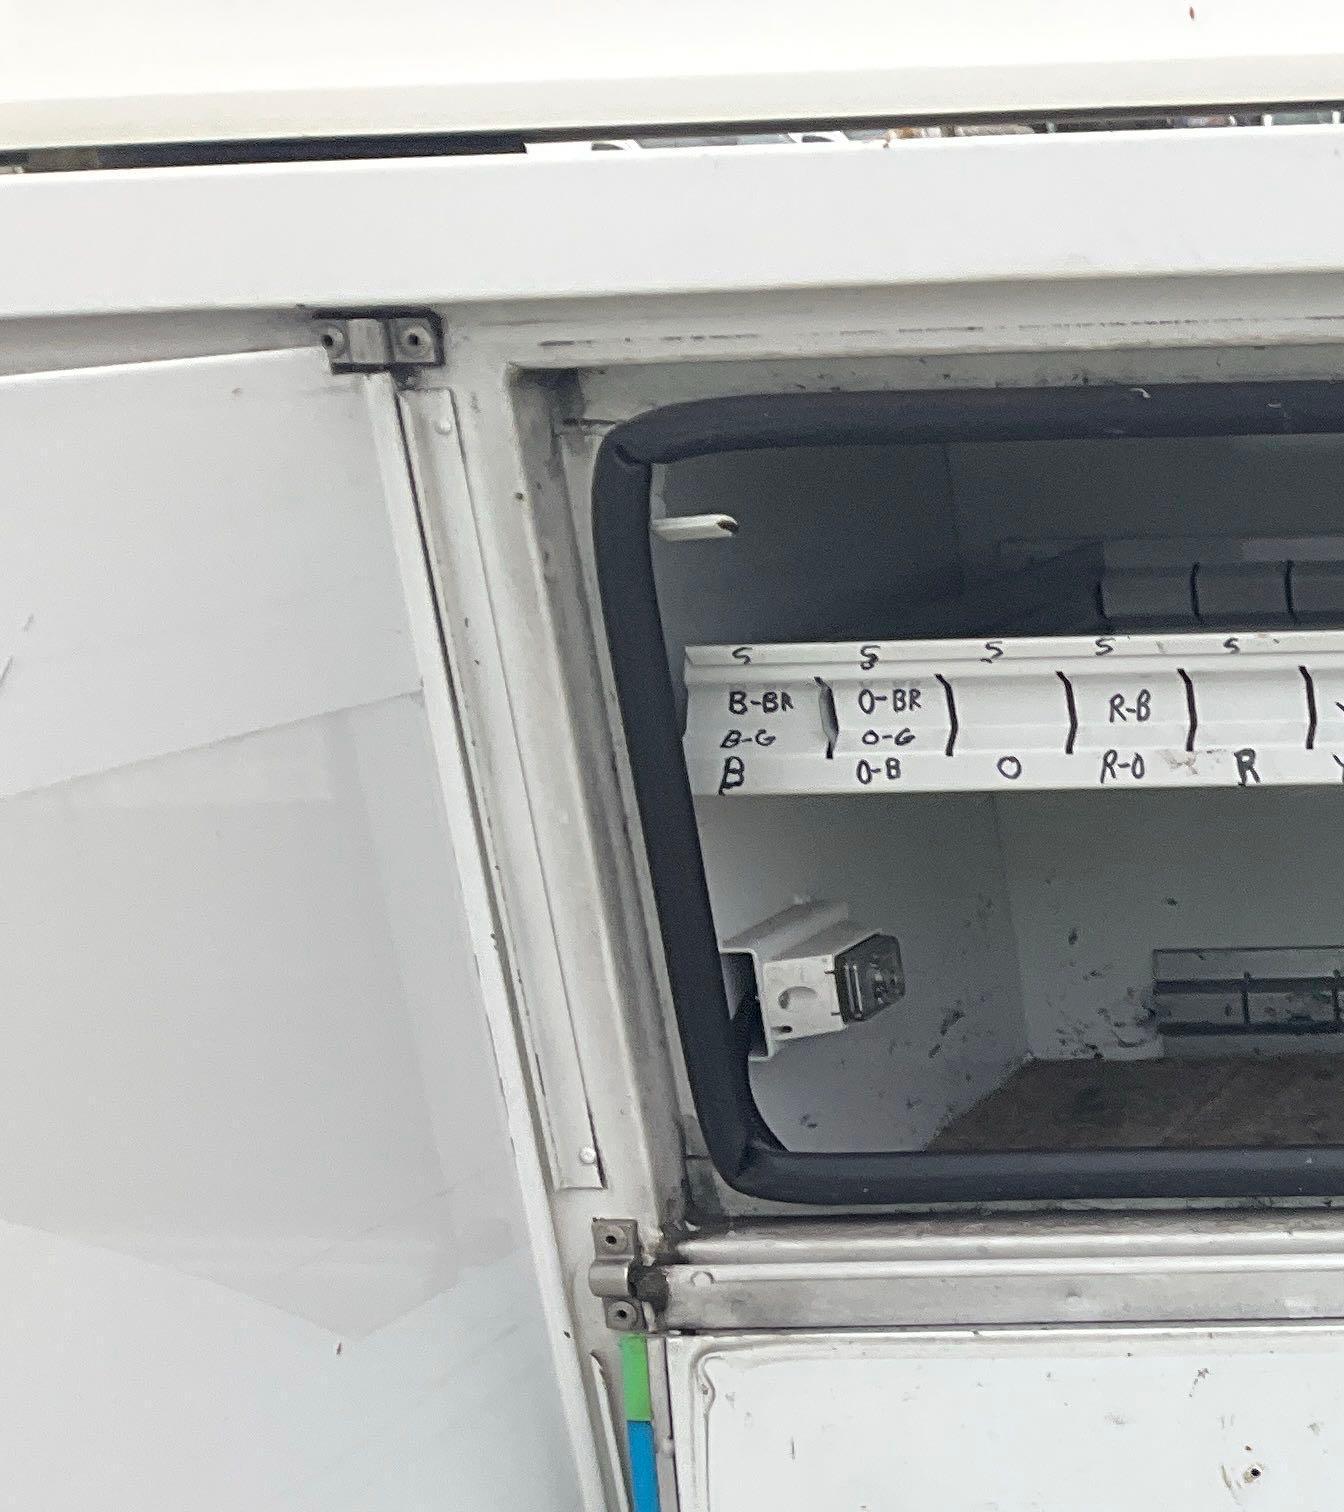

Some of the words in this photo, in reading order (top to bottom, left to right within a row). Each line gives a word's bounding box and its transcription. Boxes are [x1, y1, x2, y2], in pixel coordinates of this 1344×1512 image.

[732, 647, 752, 665] S
[1096, 636, 1116, 655] S
[1224, 638, 1241, 655] S
[728, 691, 794, 715] B-BR
[1109, 689, 1151, 722] R-B
[718, 755, 745, 796] B
[1235, 748, 1260, 786] R
